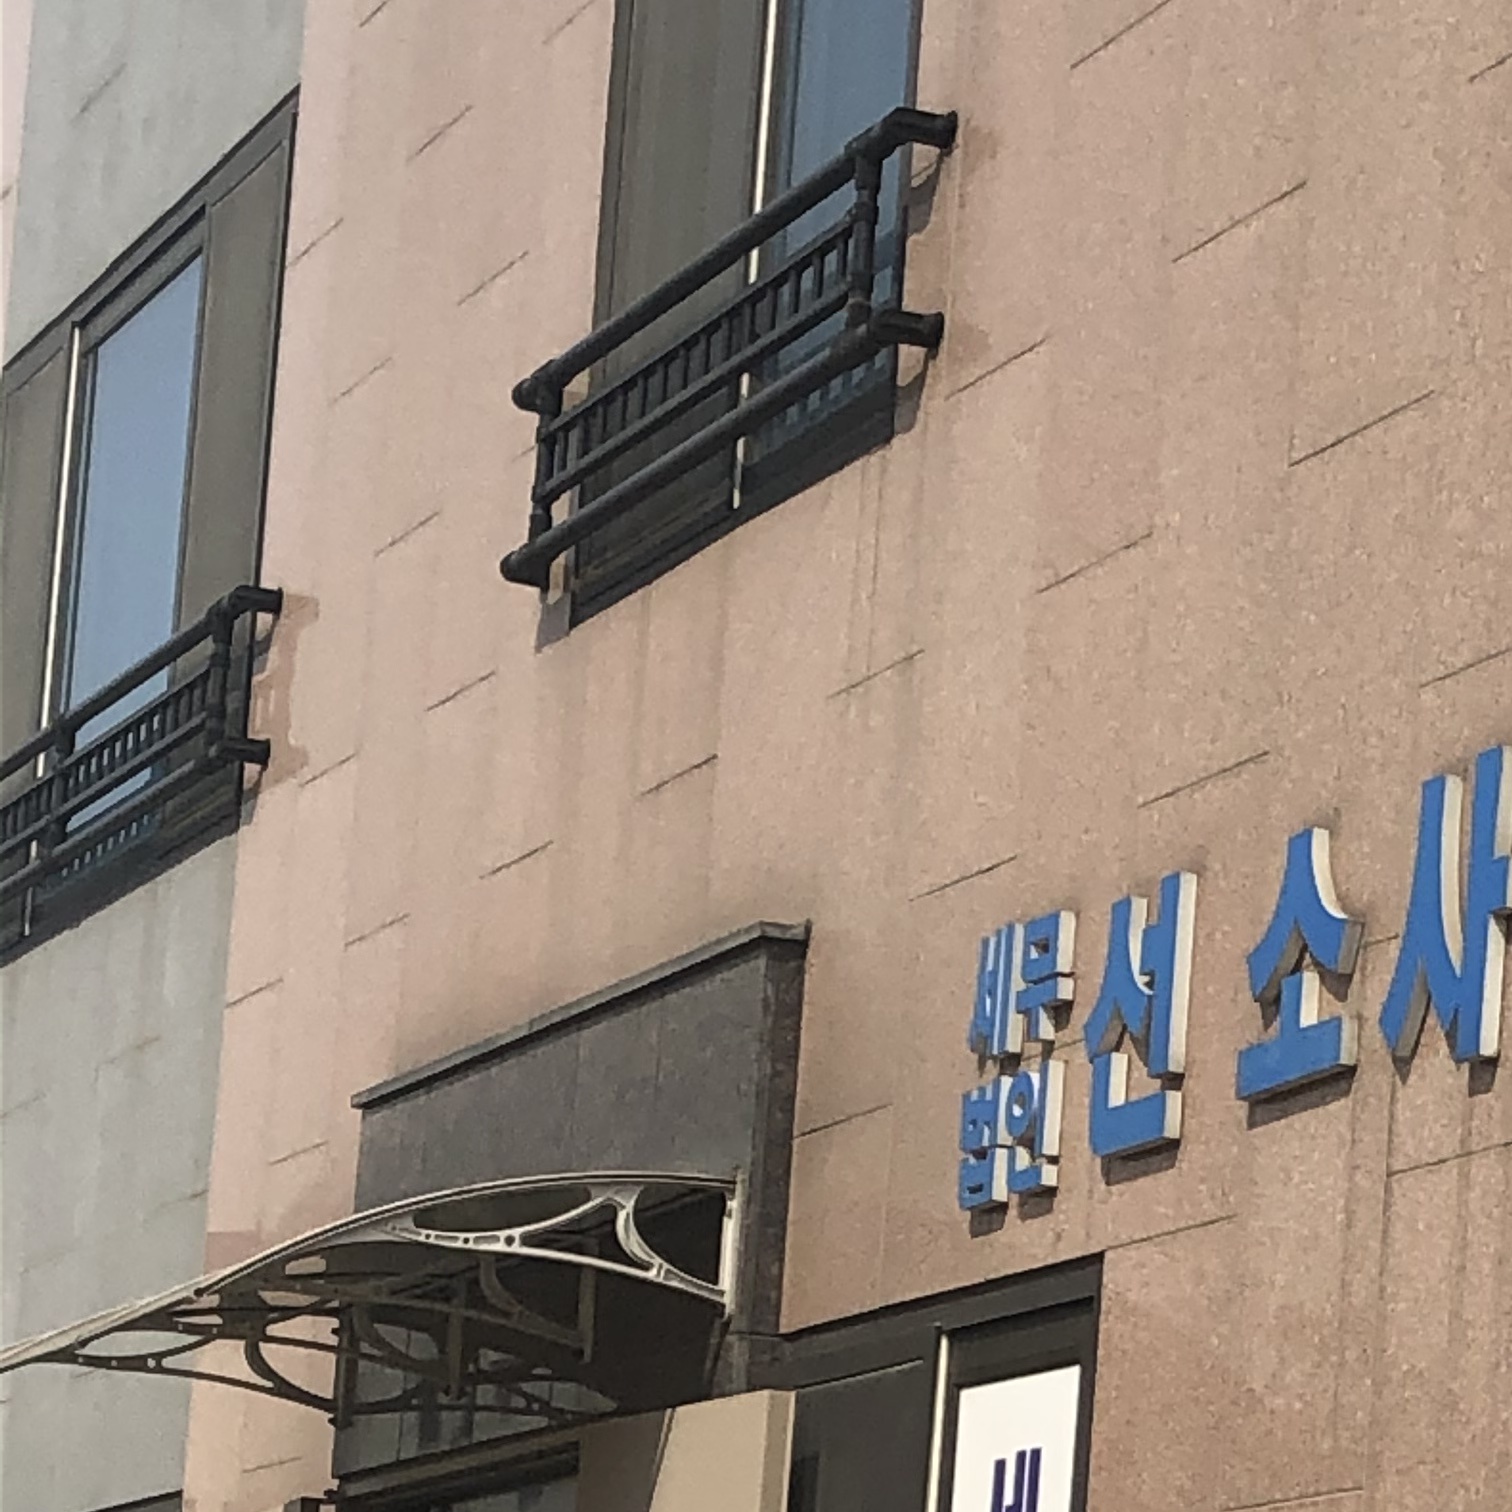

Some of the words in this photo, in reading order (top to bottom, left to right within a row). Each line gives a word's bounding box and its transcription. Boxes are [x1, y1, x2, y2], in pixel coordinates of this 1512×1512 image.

[968, 910, 1075, 1056] 세무
[1083, 869, 1198, 1159] 선
[958, 1058, 1067, 1211] 법인
